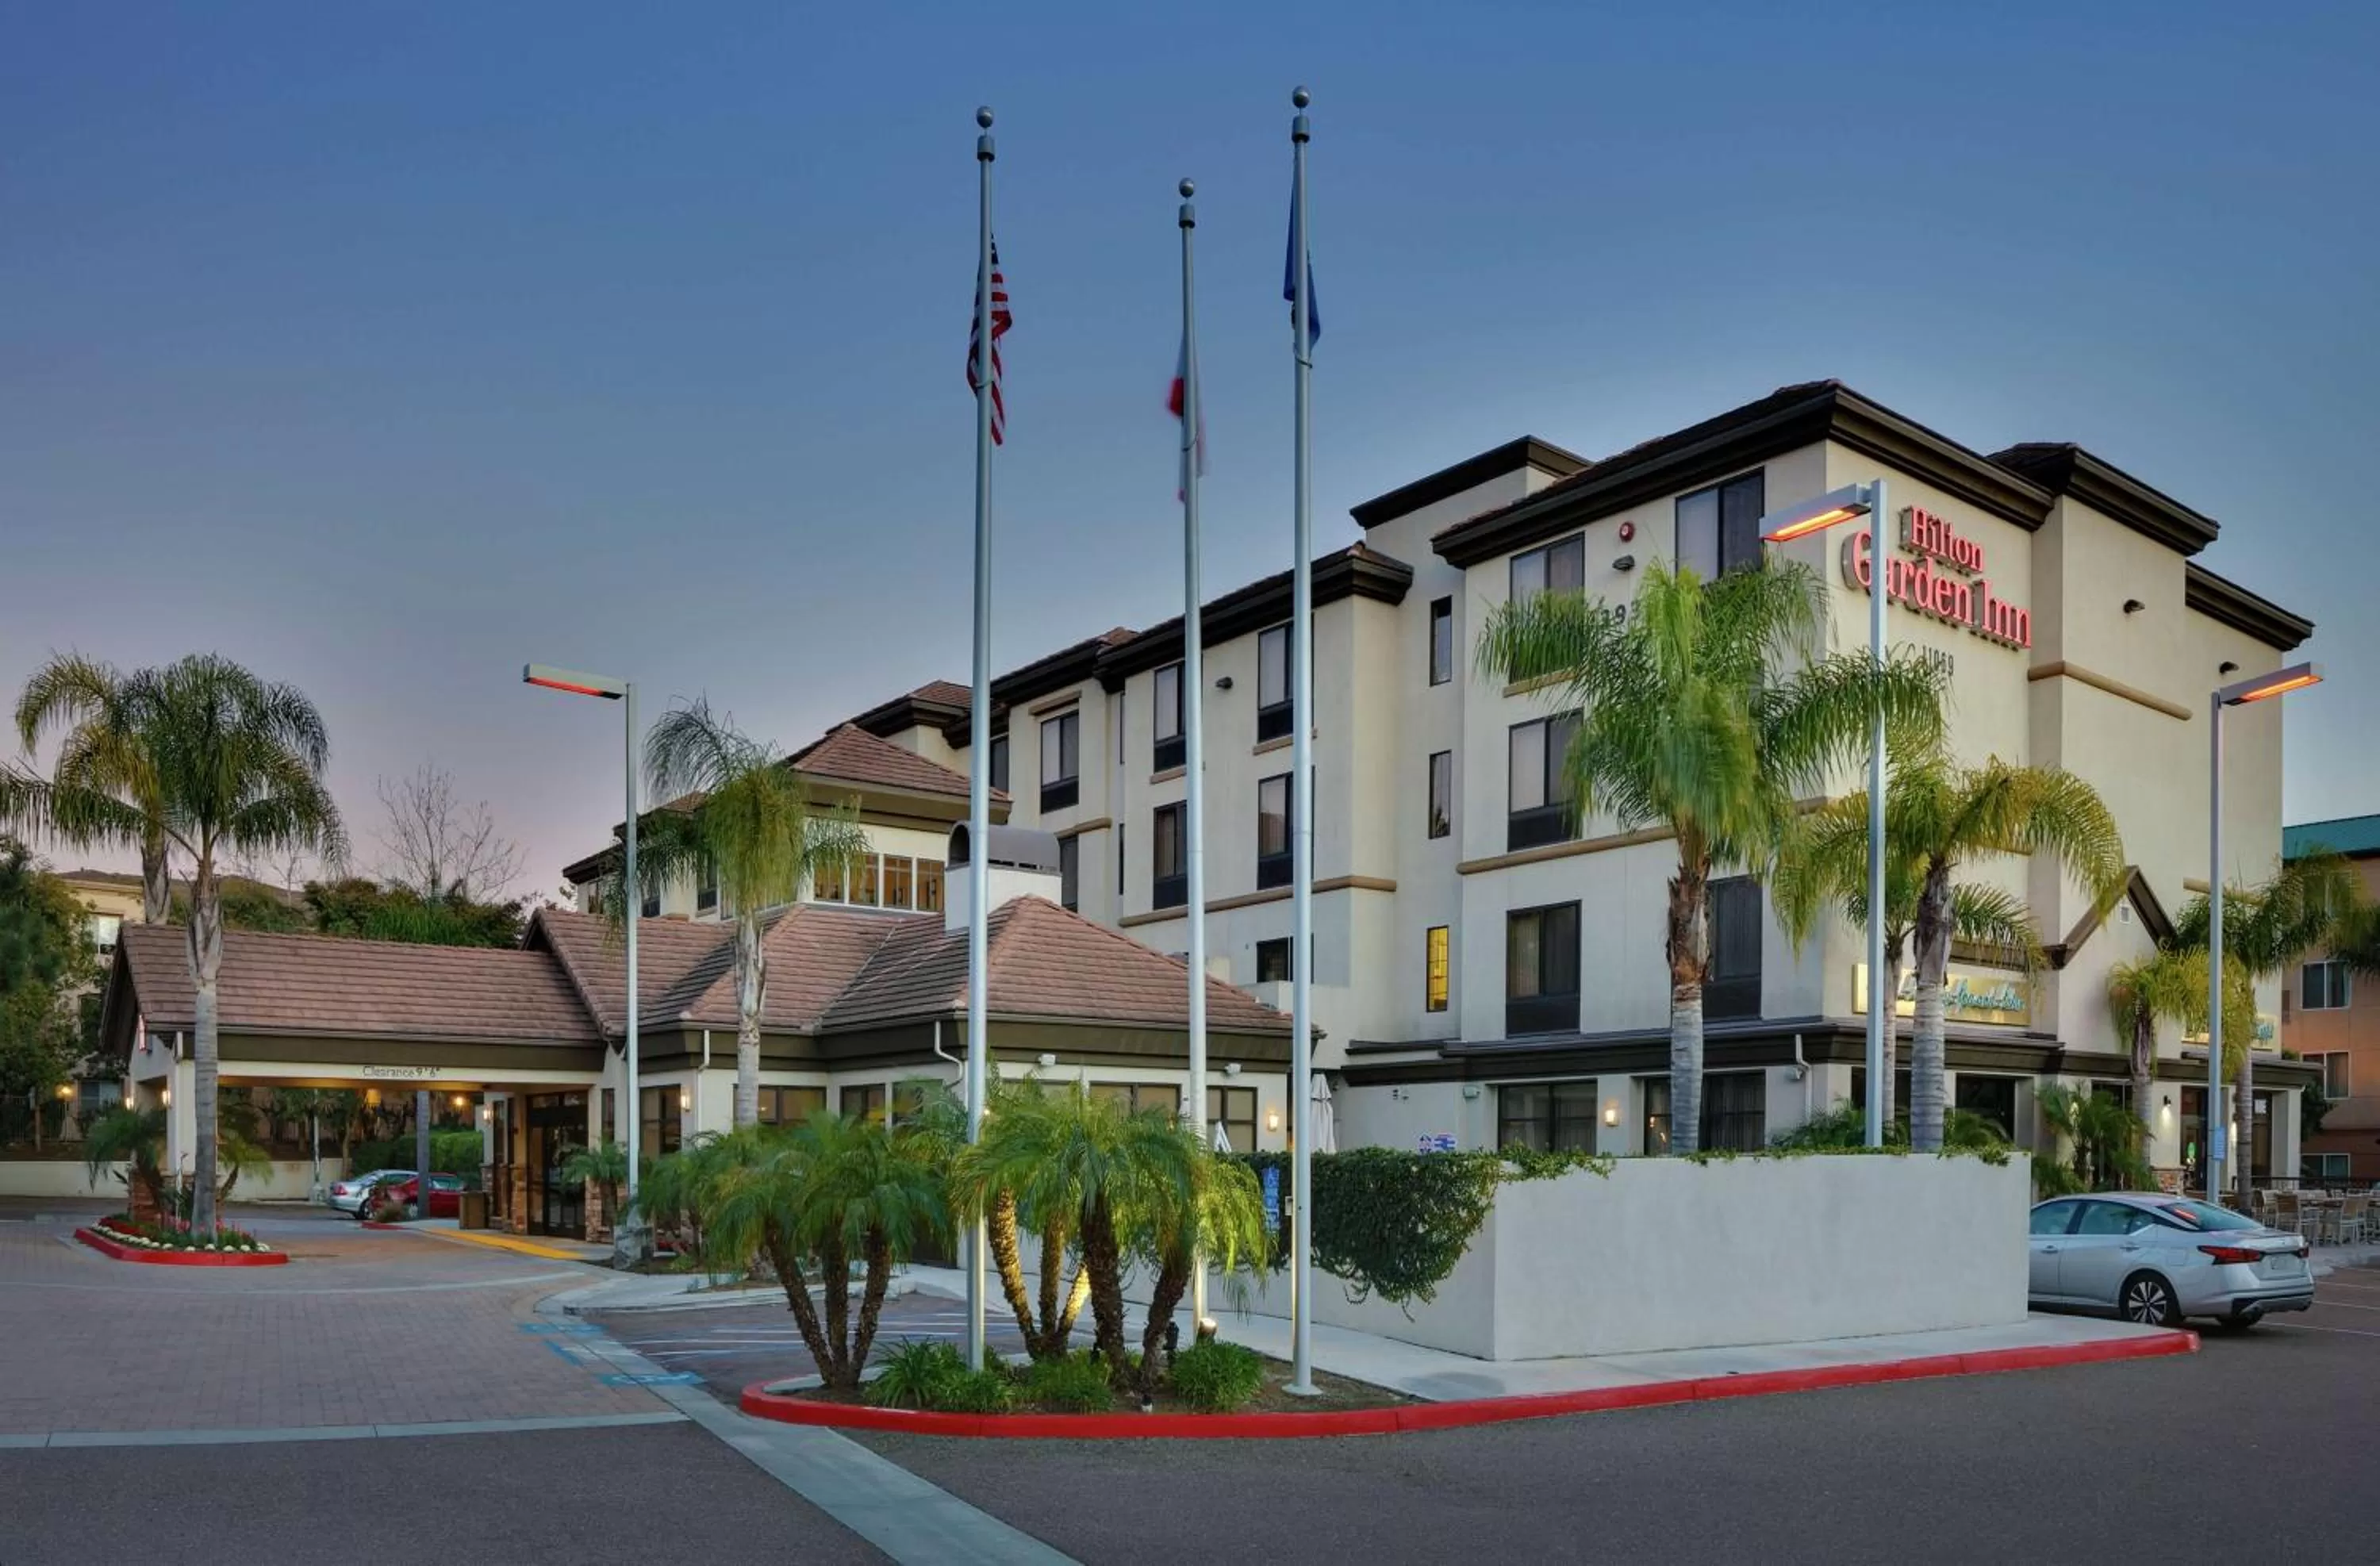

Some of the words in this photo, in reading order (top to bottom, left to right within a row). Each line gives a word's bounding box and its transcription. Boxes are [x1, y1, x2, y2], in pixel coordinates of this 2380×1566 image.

[1909, 505, 1984, 573] Hilton
[1980, 579, 2032, 649] Inn
[362, 1065, 414, 1078] Clearance
